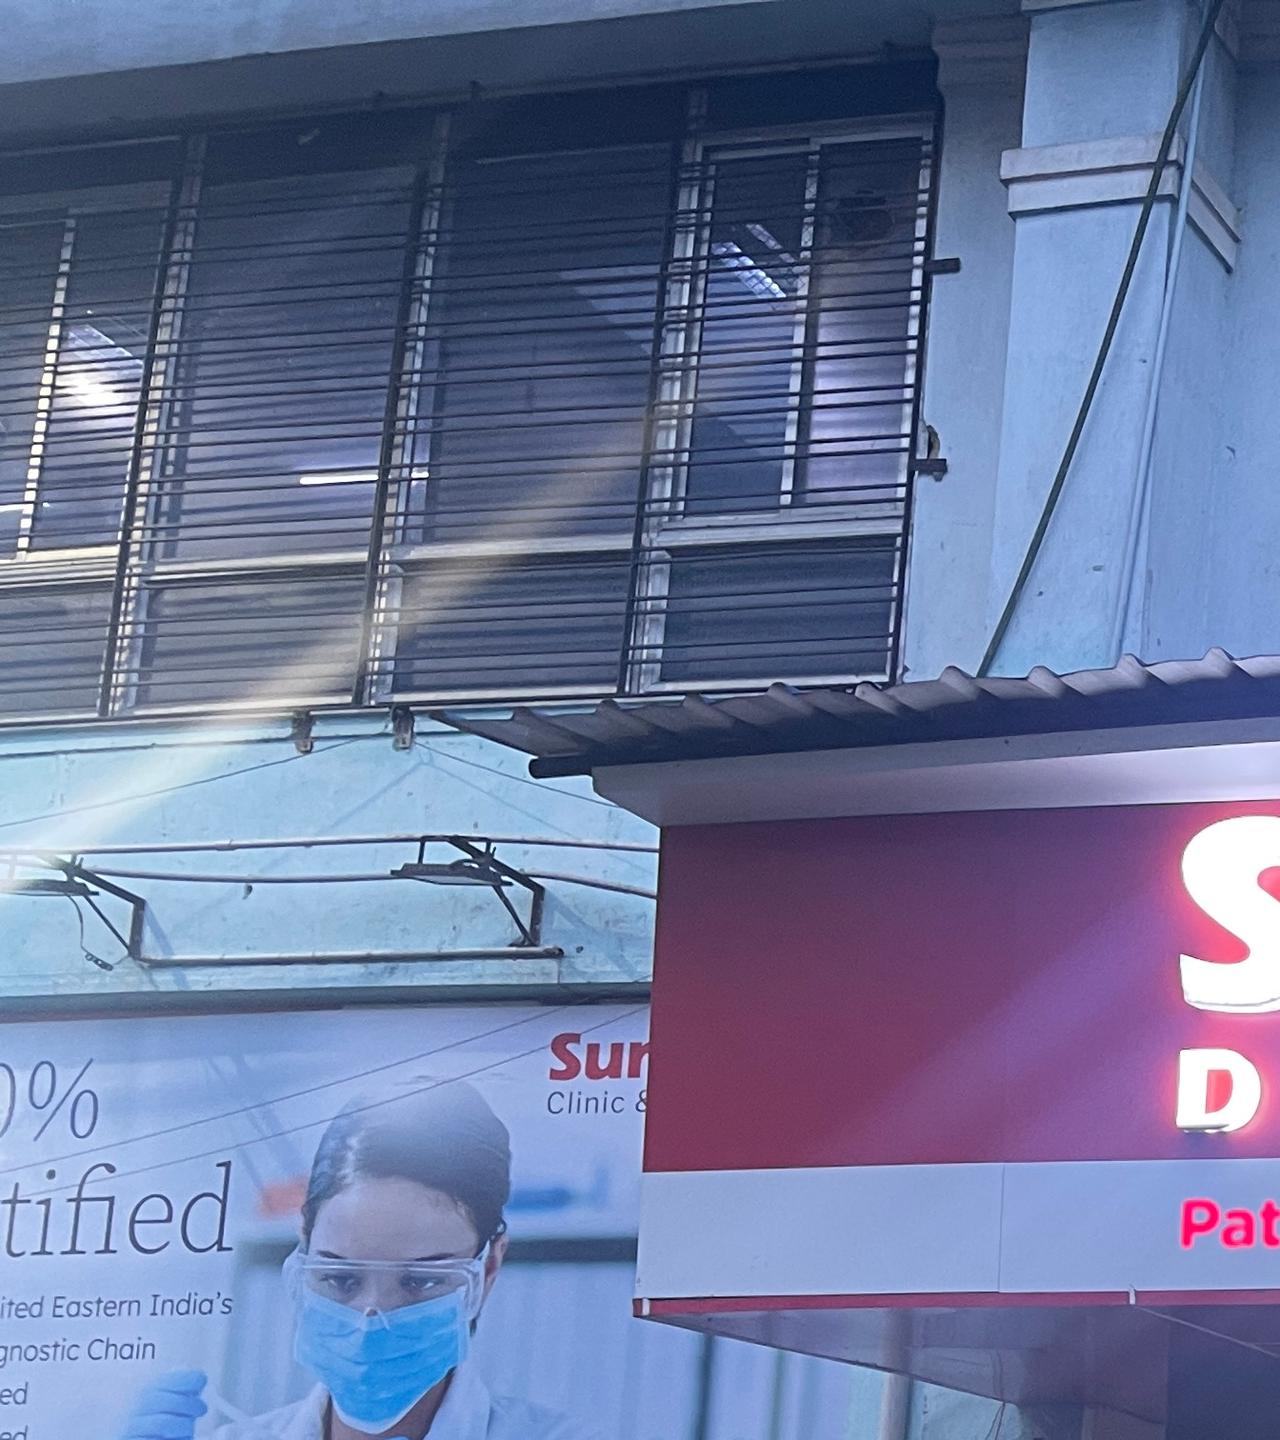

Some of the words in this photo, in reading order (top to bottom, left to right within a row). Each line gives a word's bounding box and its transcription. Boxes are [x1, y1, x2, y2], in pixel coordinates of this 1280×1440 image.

[547, 1090, 625, 1115] Clinic
[52, 1295, 141, 1319] Eastern
[149, 1291, 233, 1316] India's
[87, 1336, 156, 1361] Chain
